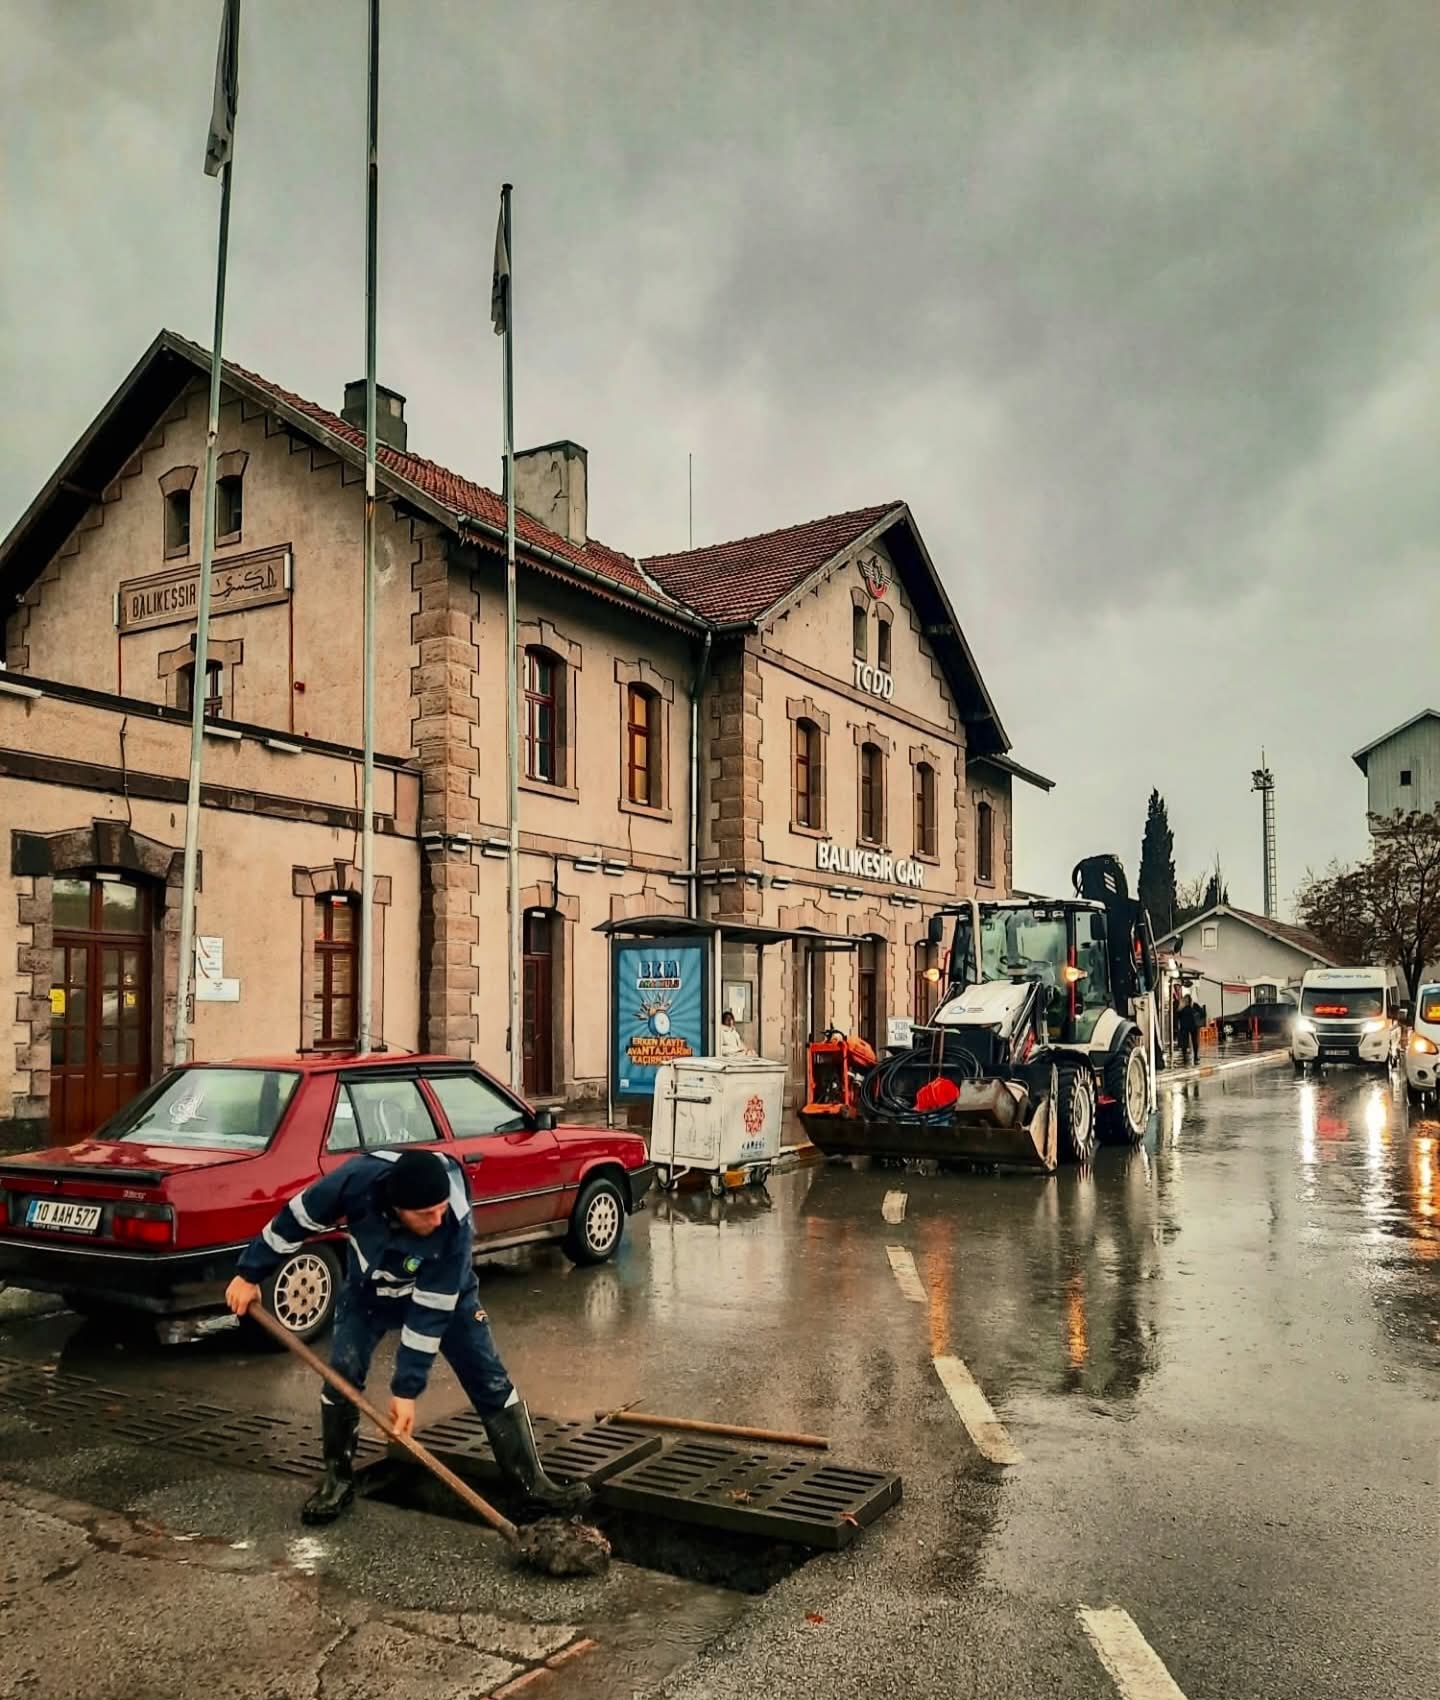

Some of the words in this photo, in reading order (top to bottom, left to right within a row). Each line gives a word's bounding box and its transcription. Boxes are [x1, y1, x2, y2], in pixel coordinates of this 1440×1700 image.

[853, 659, 894, 699] TCDD
[817, 840, 893, 881] BALIKESİR
[895, 859, 924, 887] GAR
[640, 960, 678, 979] BKM
[632, 1037, 658, 1046] ERKEN
[659, 1038, 685, 1048] KAYIT
[36, 1204, 49, 1221] 10
[51, 1205, 74, 1224] AAH
[74, 1207, 98, 1227] 577
